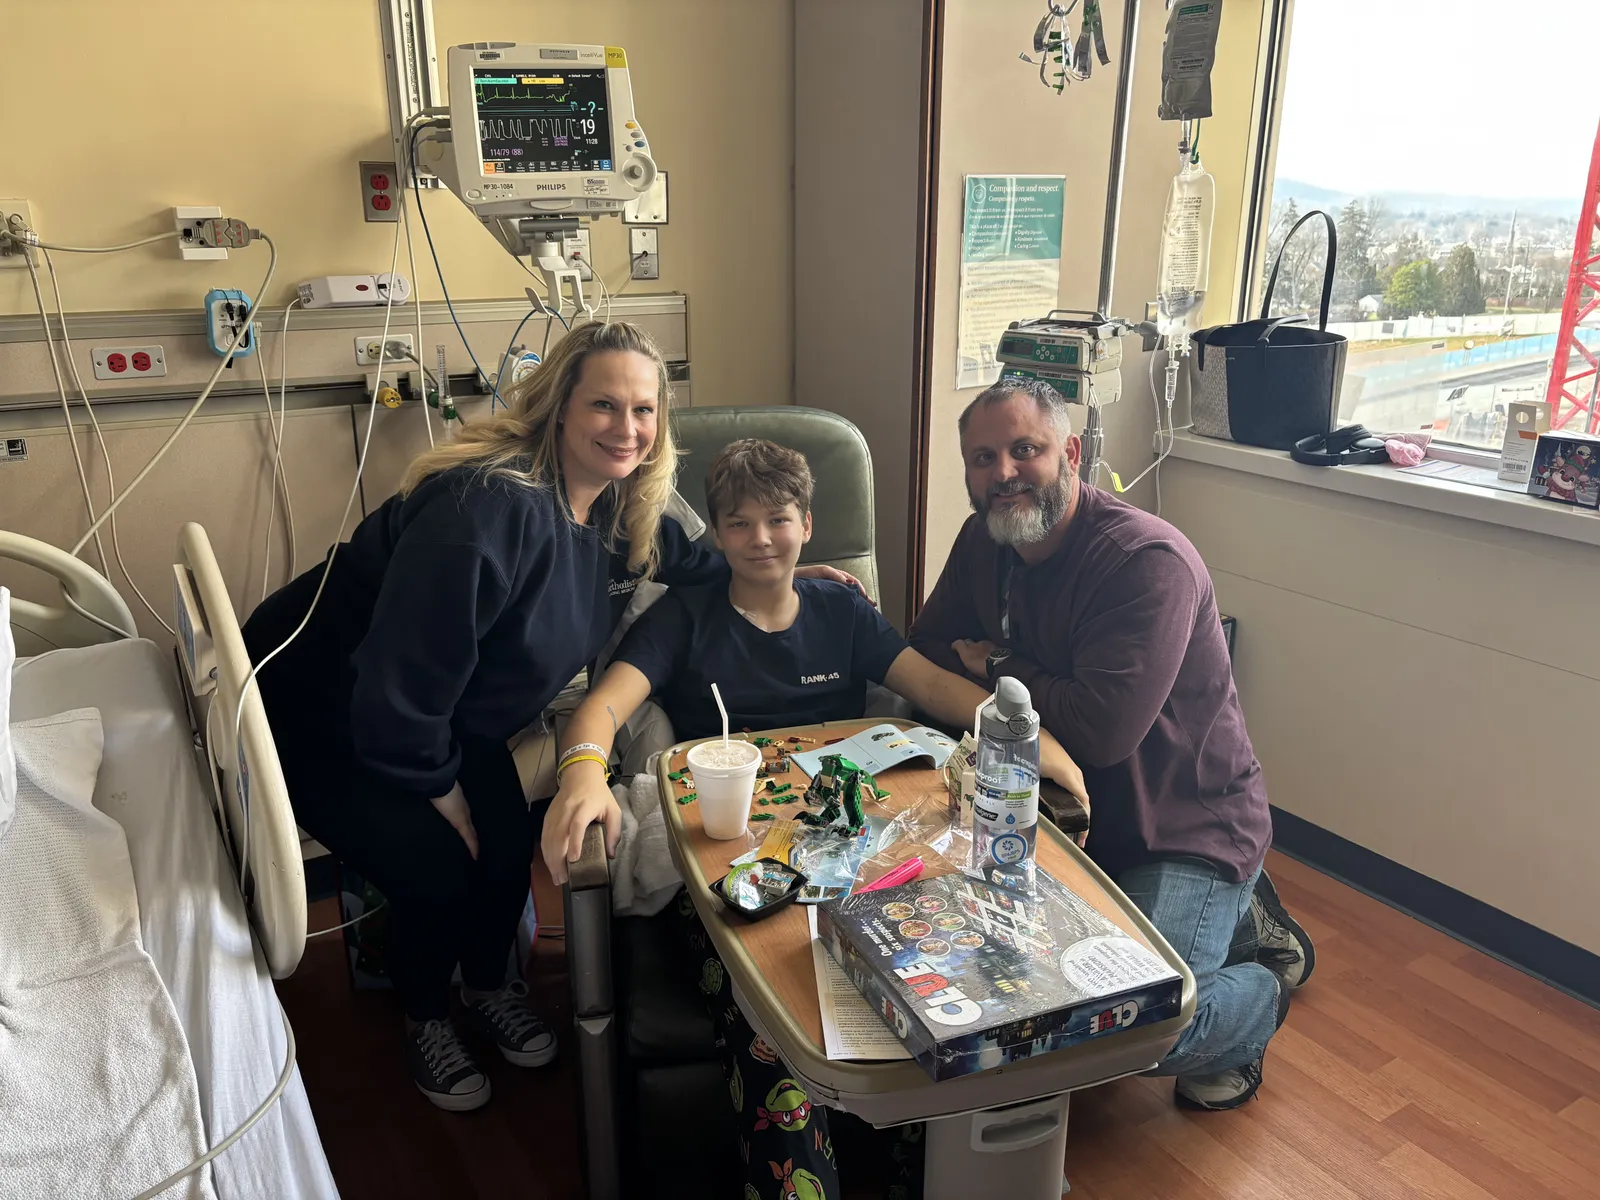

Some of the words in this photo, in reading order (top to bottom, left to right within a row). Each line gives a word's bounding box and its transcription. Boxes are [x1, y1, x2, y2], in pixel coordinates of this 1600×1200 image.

[580, 118, 596, 135] 19
[490, 148, 510, 157] 114/79
[511, 148, 524, 156] (88)
[536, 183, 567, 191] PHILIPS
[989, 184, 1025, 194] Compion
[1026, 184, 1038, 193] and
[1038, 184, 1060, 194] respect.
[879, 944, 892, 957] One
[891, 941, 904, 951] six
[893, 962, 982, 1026] CLUE
[881, 995, 909, 1039] CLUE
[1089, 1000, 1139, 1035] CLUE
